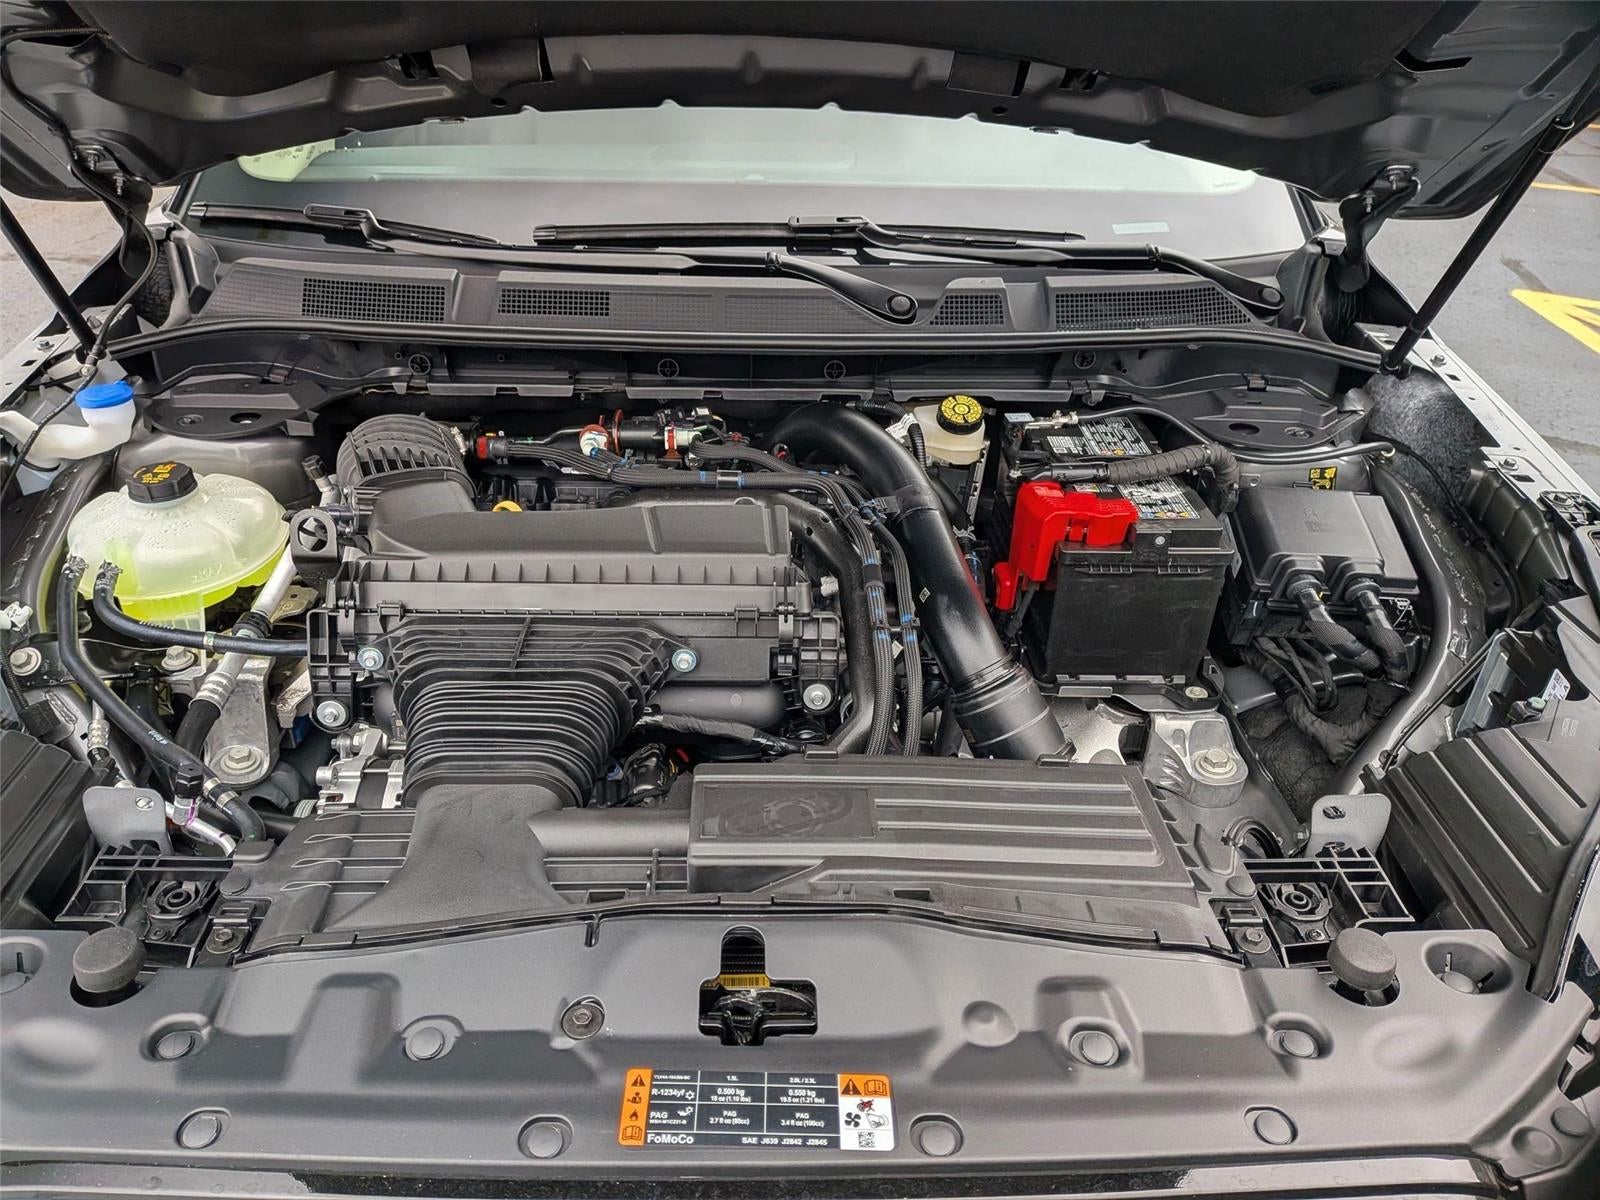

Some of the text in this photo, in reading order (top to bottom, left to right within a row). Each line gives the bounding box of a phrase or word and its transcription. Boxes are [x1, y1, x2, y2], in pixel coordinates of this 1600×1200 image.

[652, 1088, 684, 1098] R-1234yf
[807, 1090, 816, 1098] kg
[647, 1134, 694, 1144] FoMoCo
